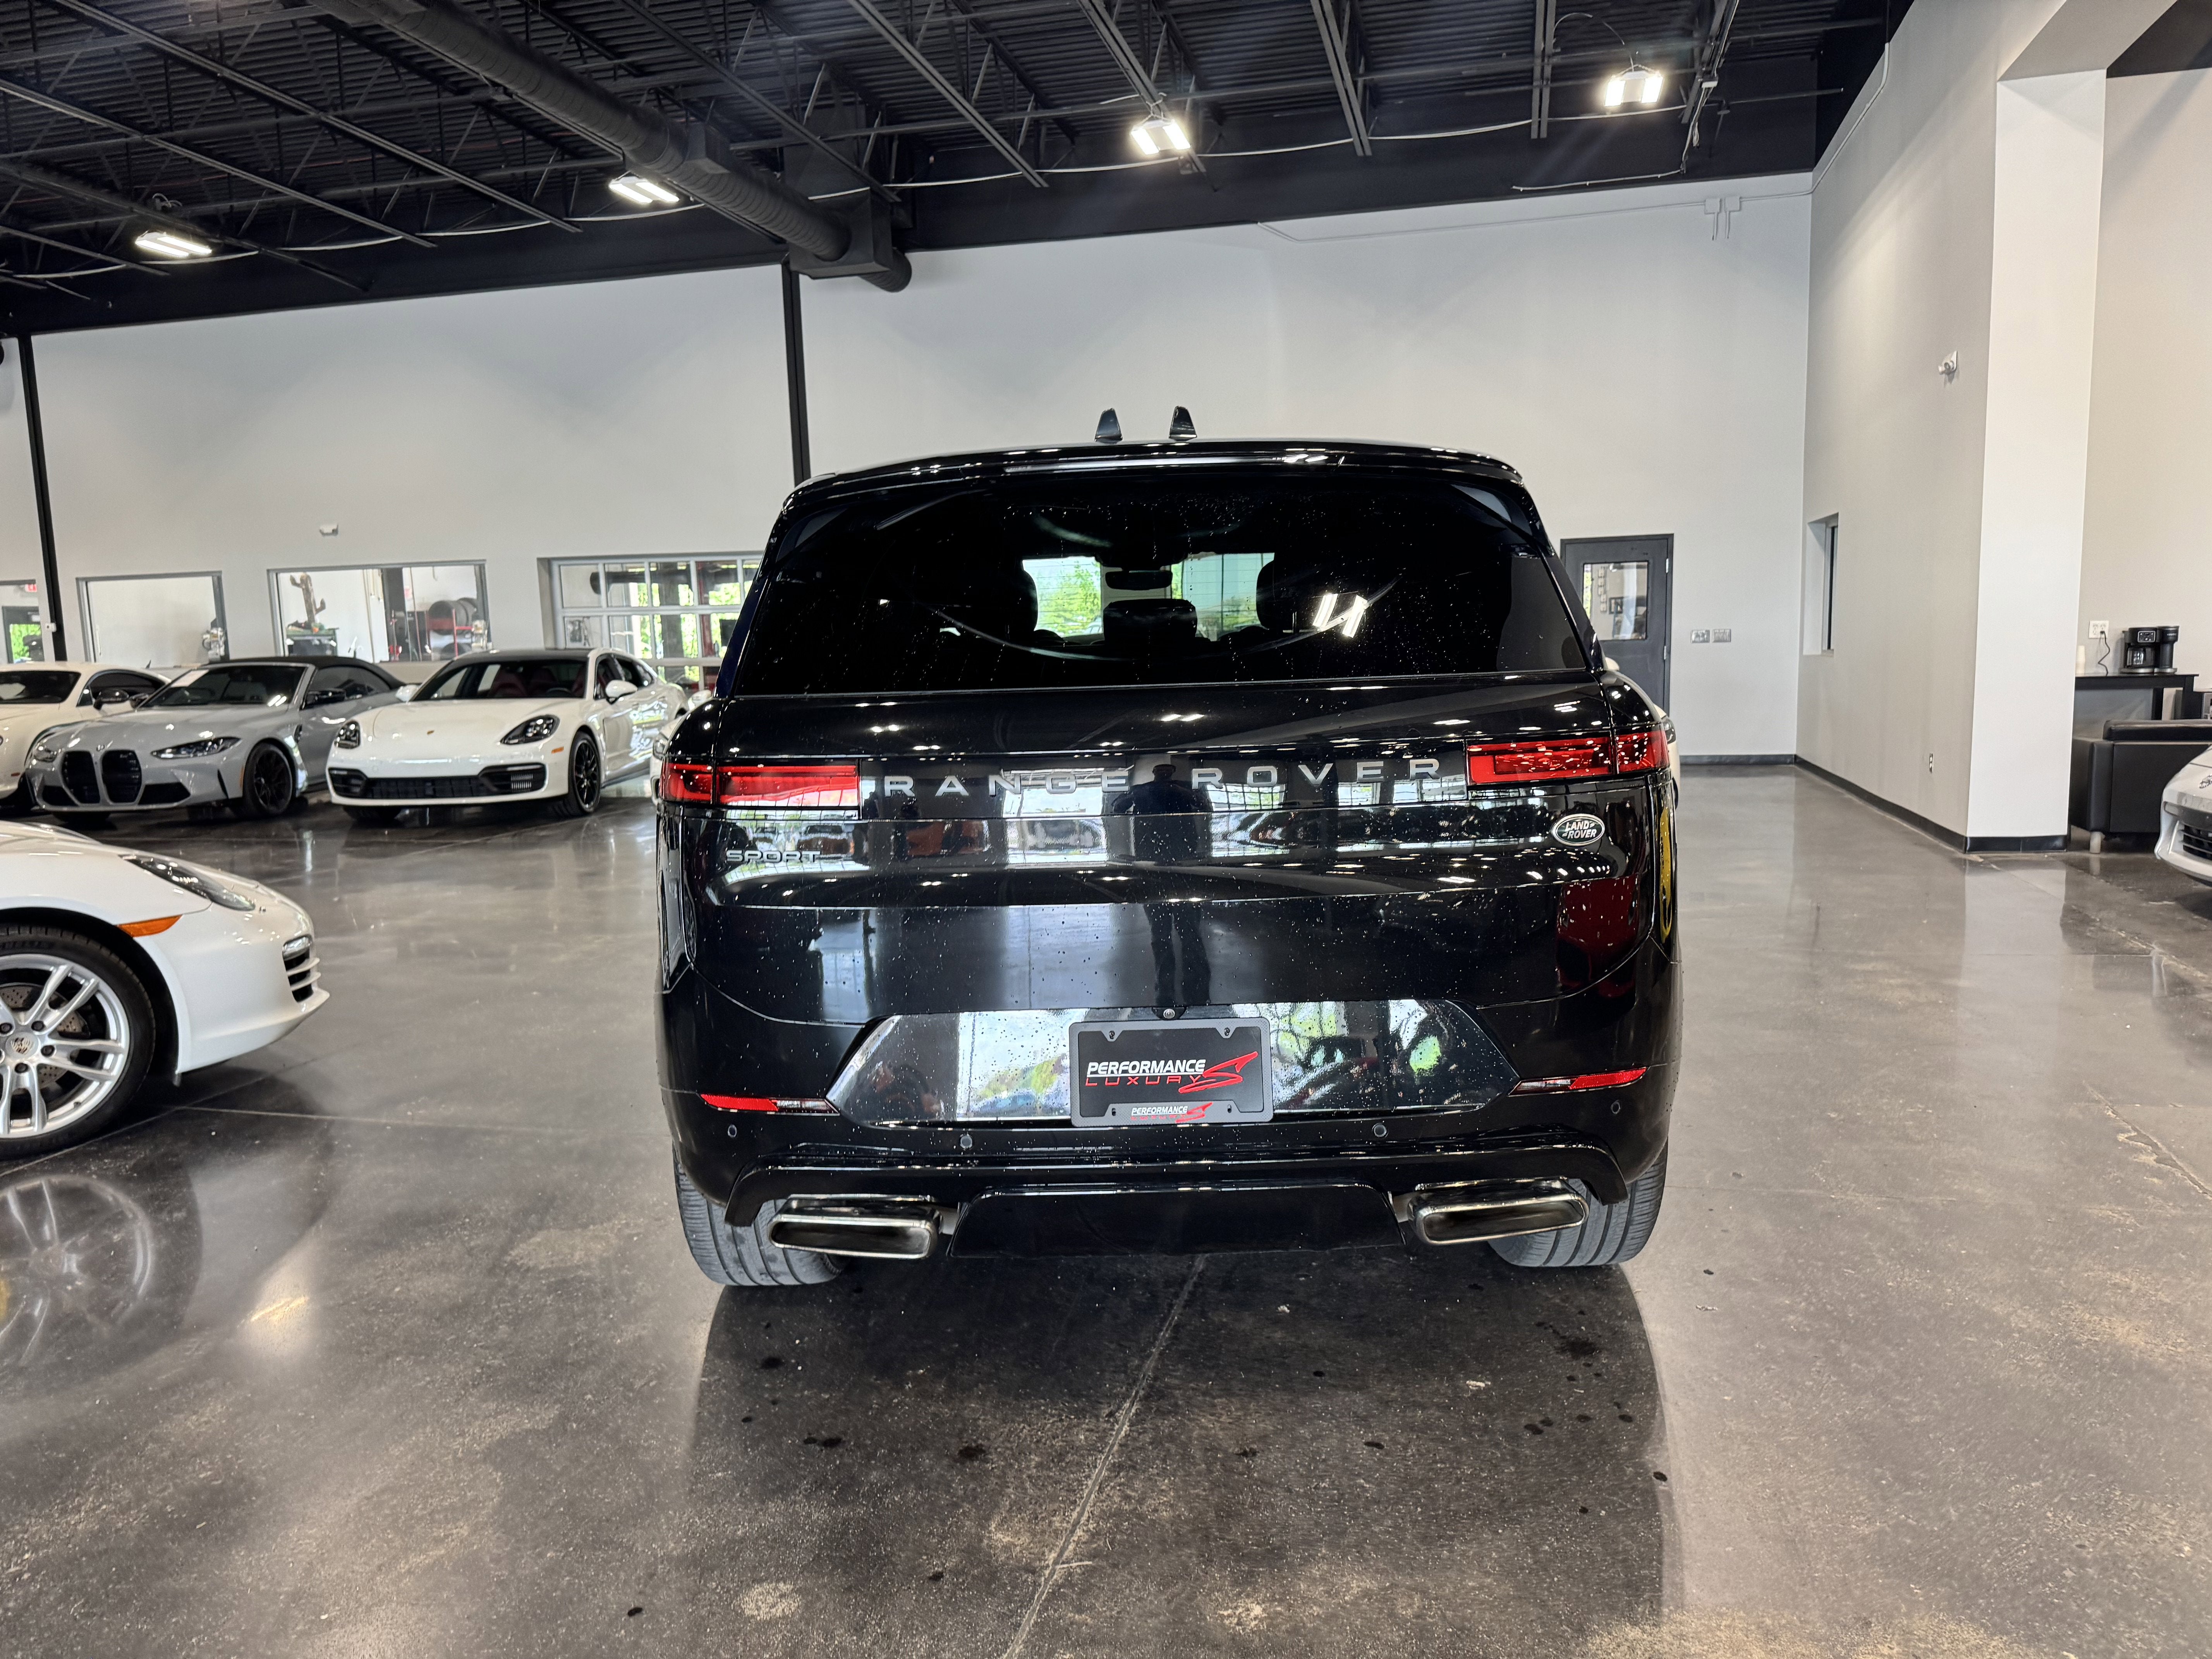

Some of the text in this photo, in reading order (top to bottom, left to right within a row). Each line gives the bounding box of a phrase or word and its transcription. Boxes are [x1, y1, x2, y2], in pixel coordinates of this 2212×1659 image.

[884, 758, 1441, 797] RANGE ROVER
[1565, 820, 1590, 832] LAND
[1567, 829, 1597, 839] ROVER
[726, 850, 821, 863] SPORT
[1087, 1059, 1206, 1075] PERFORMANCE
[1085, 1074, 1202, 1087] LUXURY
[1131, 1105, 1188, 1115] PERFORMANCE
